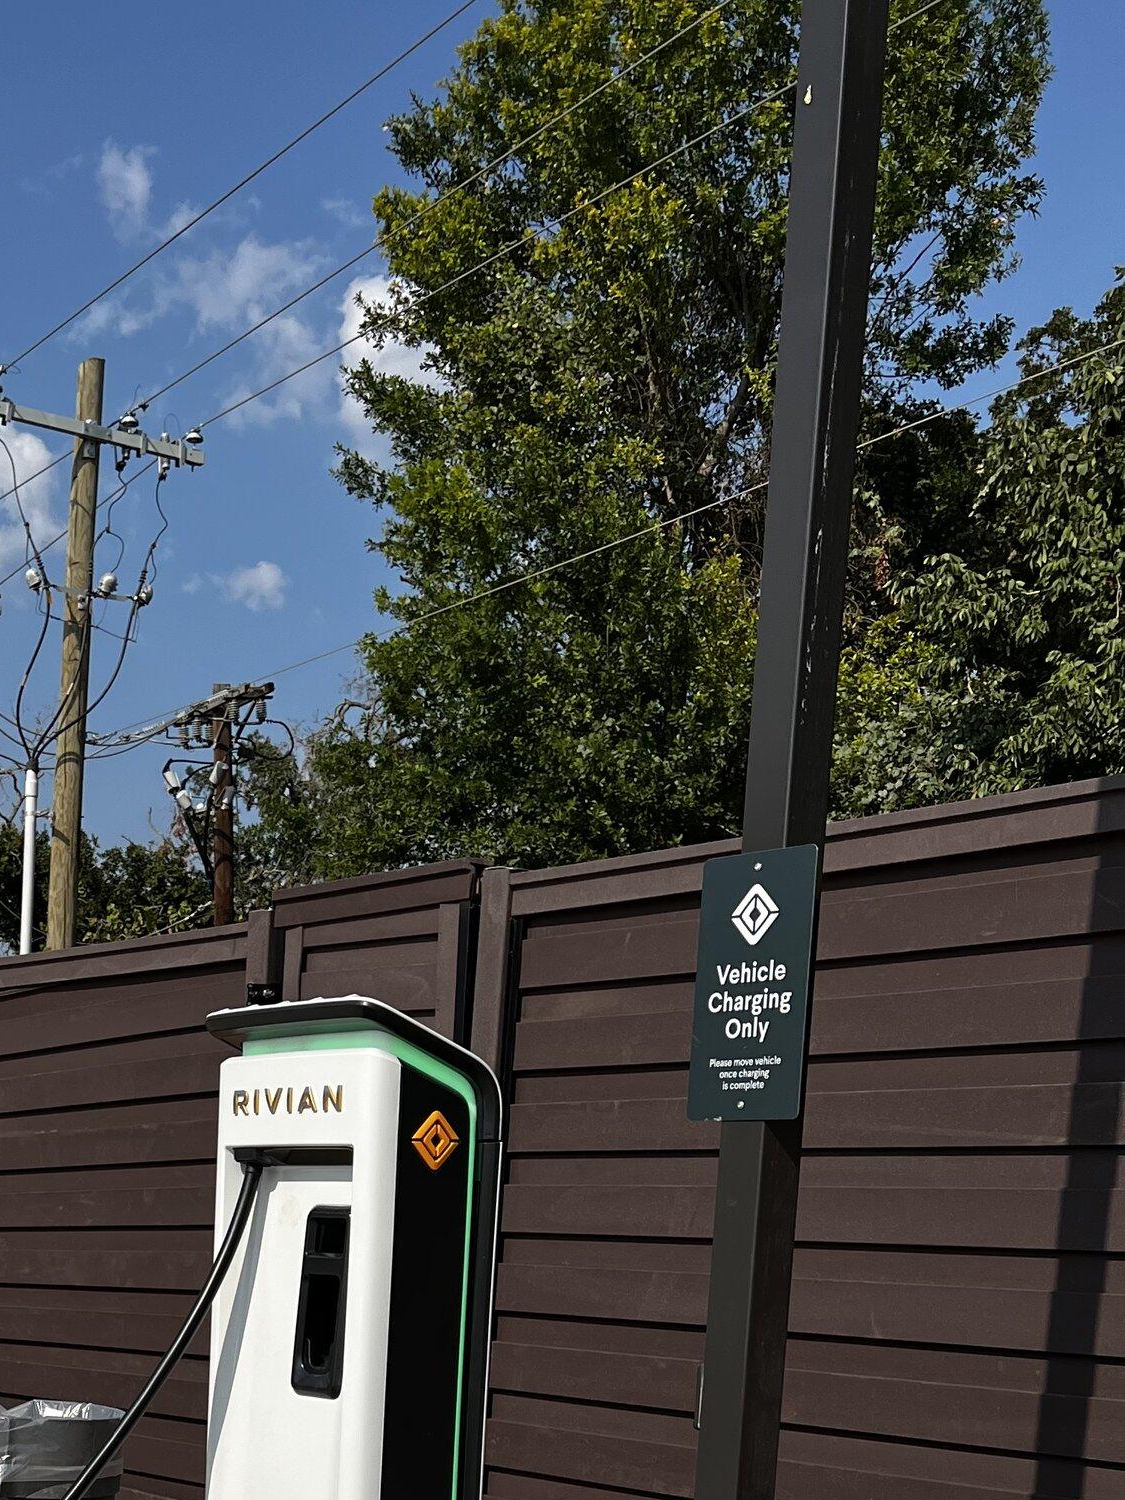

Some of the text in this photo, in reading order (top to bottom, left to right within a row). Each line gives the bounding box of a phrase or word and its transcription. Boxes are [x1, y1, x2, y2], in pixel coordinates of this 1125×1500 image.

[716, 959, 786, 985] Vehicle
[708, 988, 792, 1015] Charging
[725, 1016, 769, 1043] Only
[709, 1055, 782, 1068] Please move vehicle
[719, 1068, 770, 1081] once charging
[722, 1080, 765, 1091] is complete
[232, 1084, 345, 1117] RIVIAN
